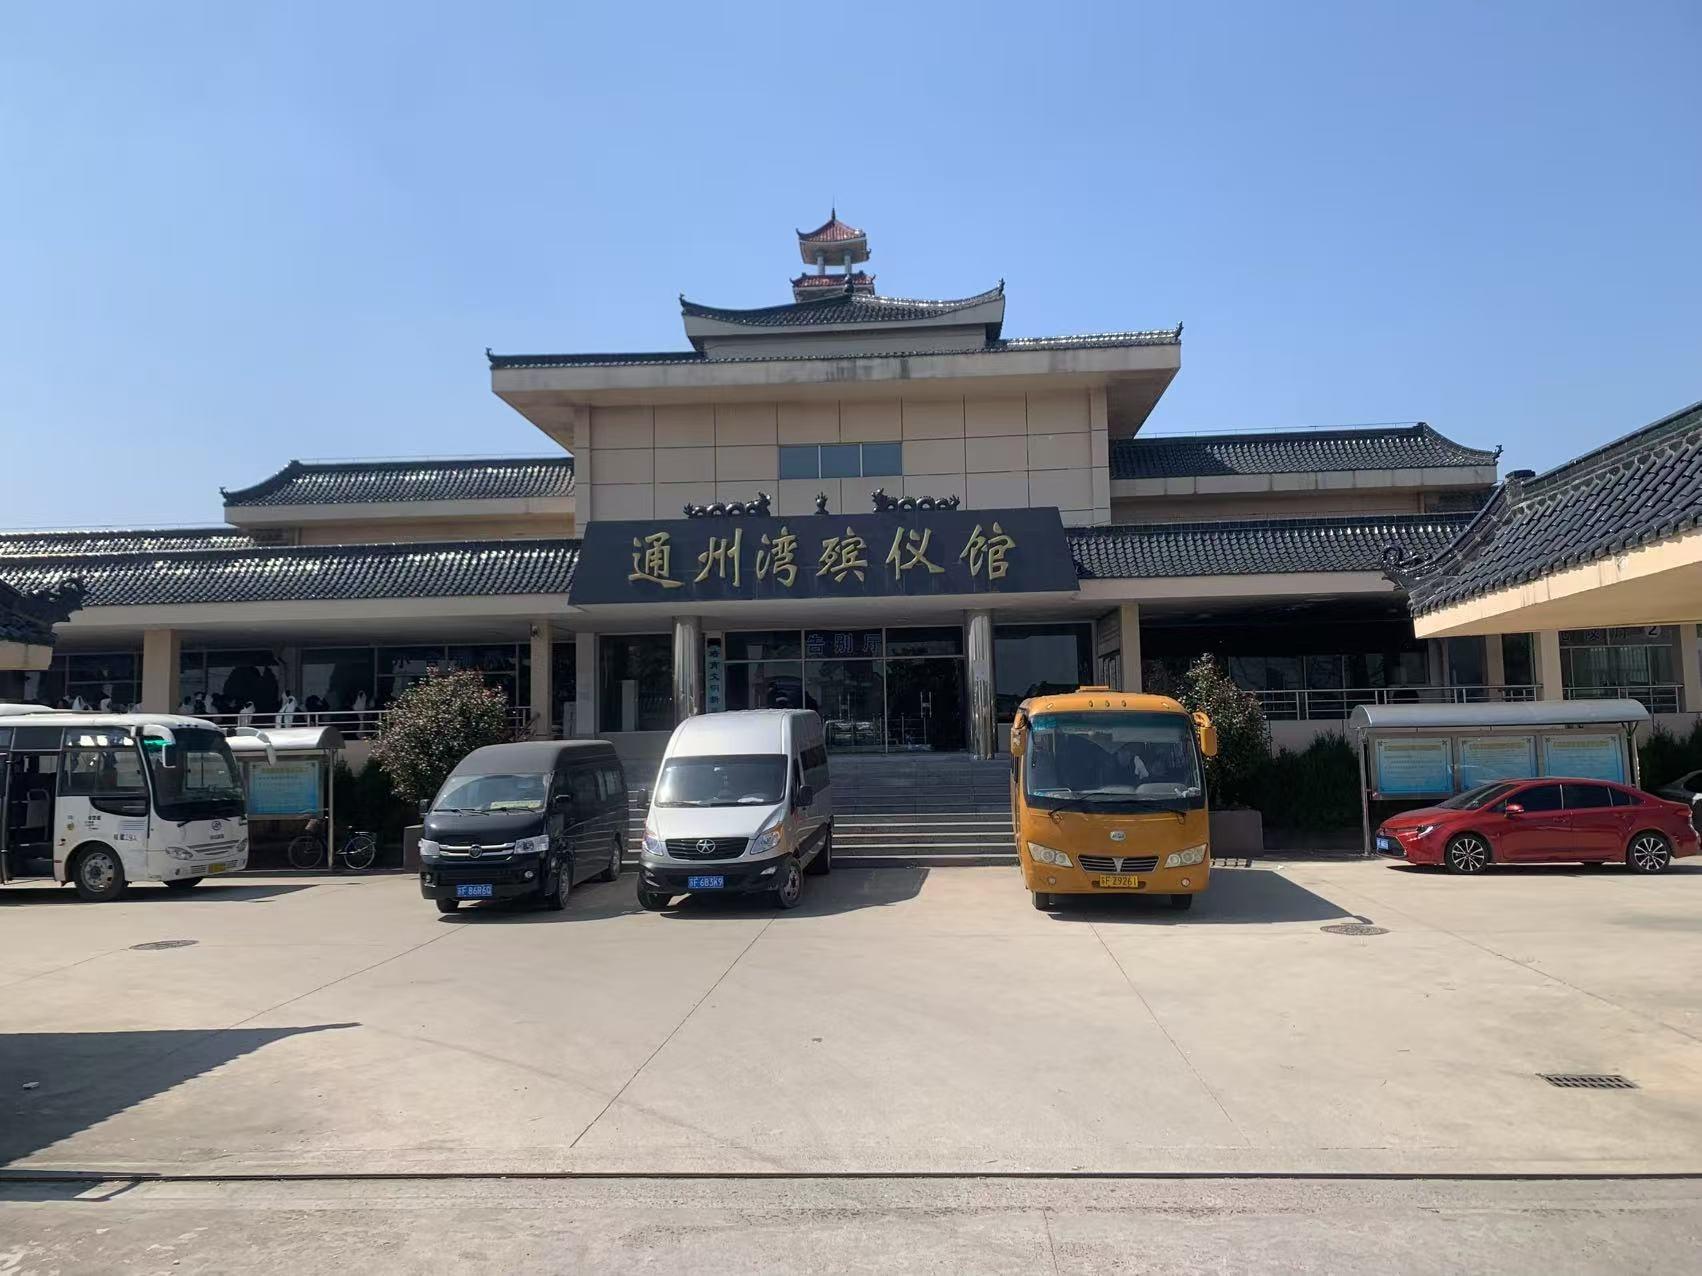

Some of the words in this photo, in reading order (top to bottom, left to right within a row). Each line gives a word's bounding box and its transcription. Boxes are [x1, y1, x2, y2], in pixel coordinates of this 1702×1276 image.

[628, 521, 1016, 589] 通州湾殡仪馆
[806, 633, 882, 657] 告别厅
